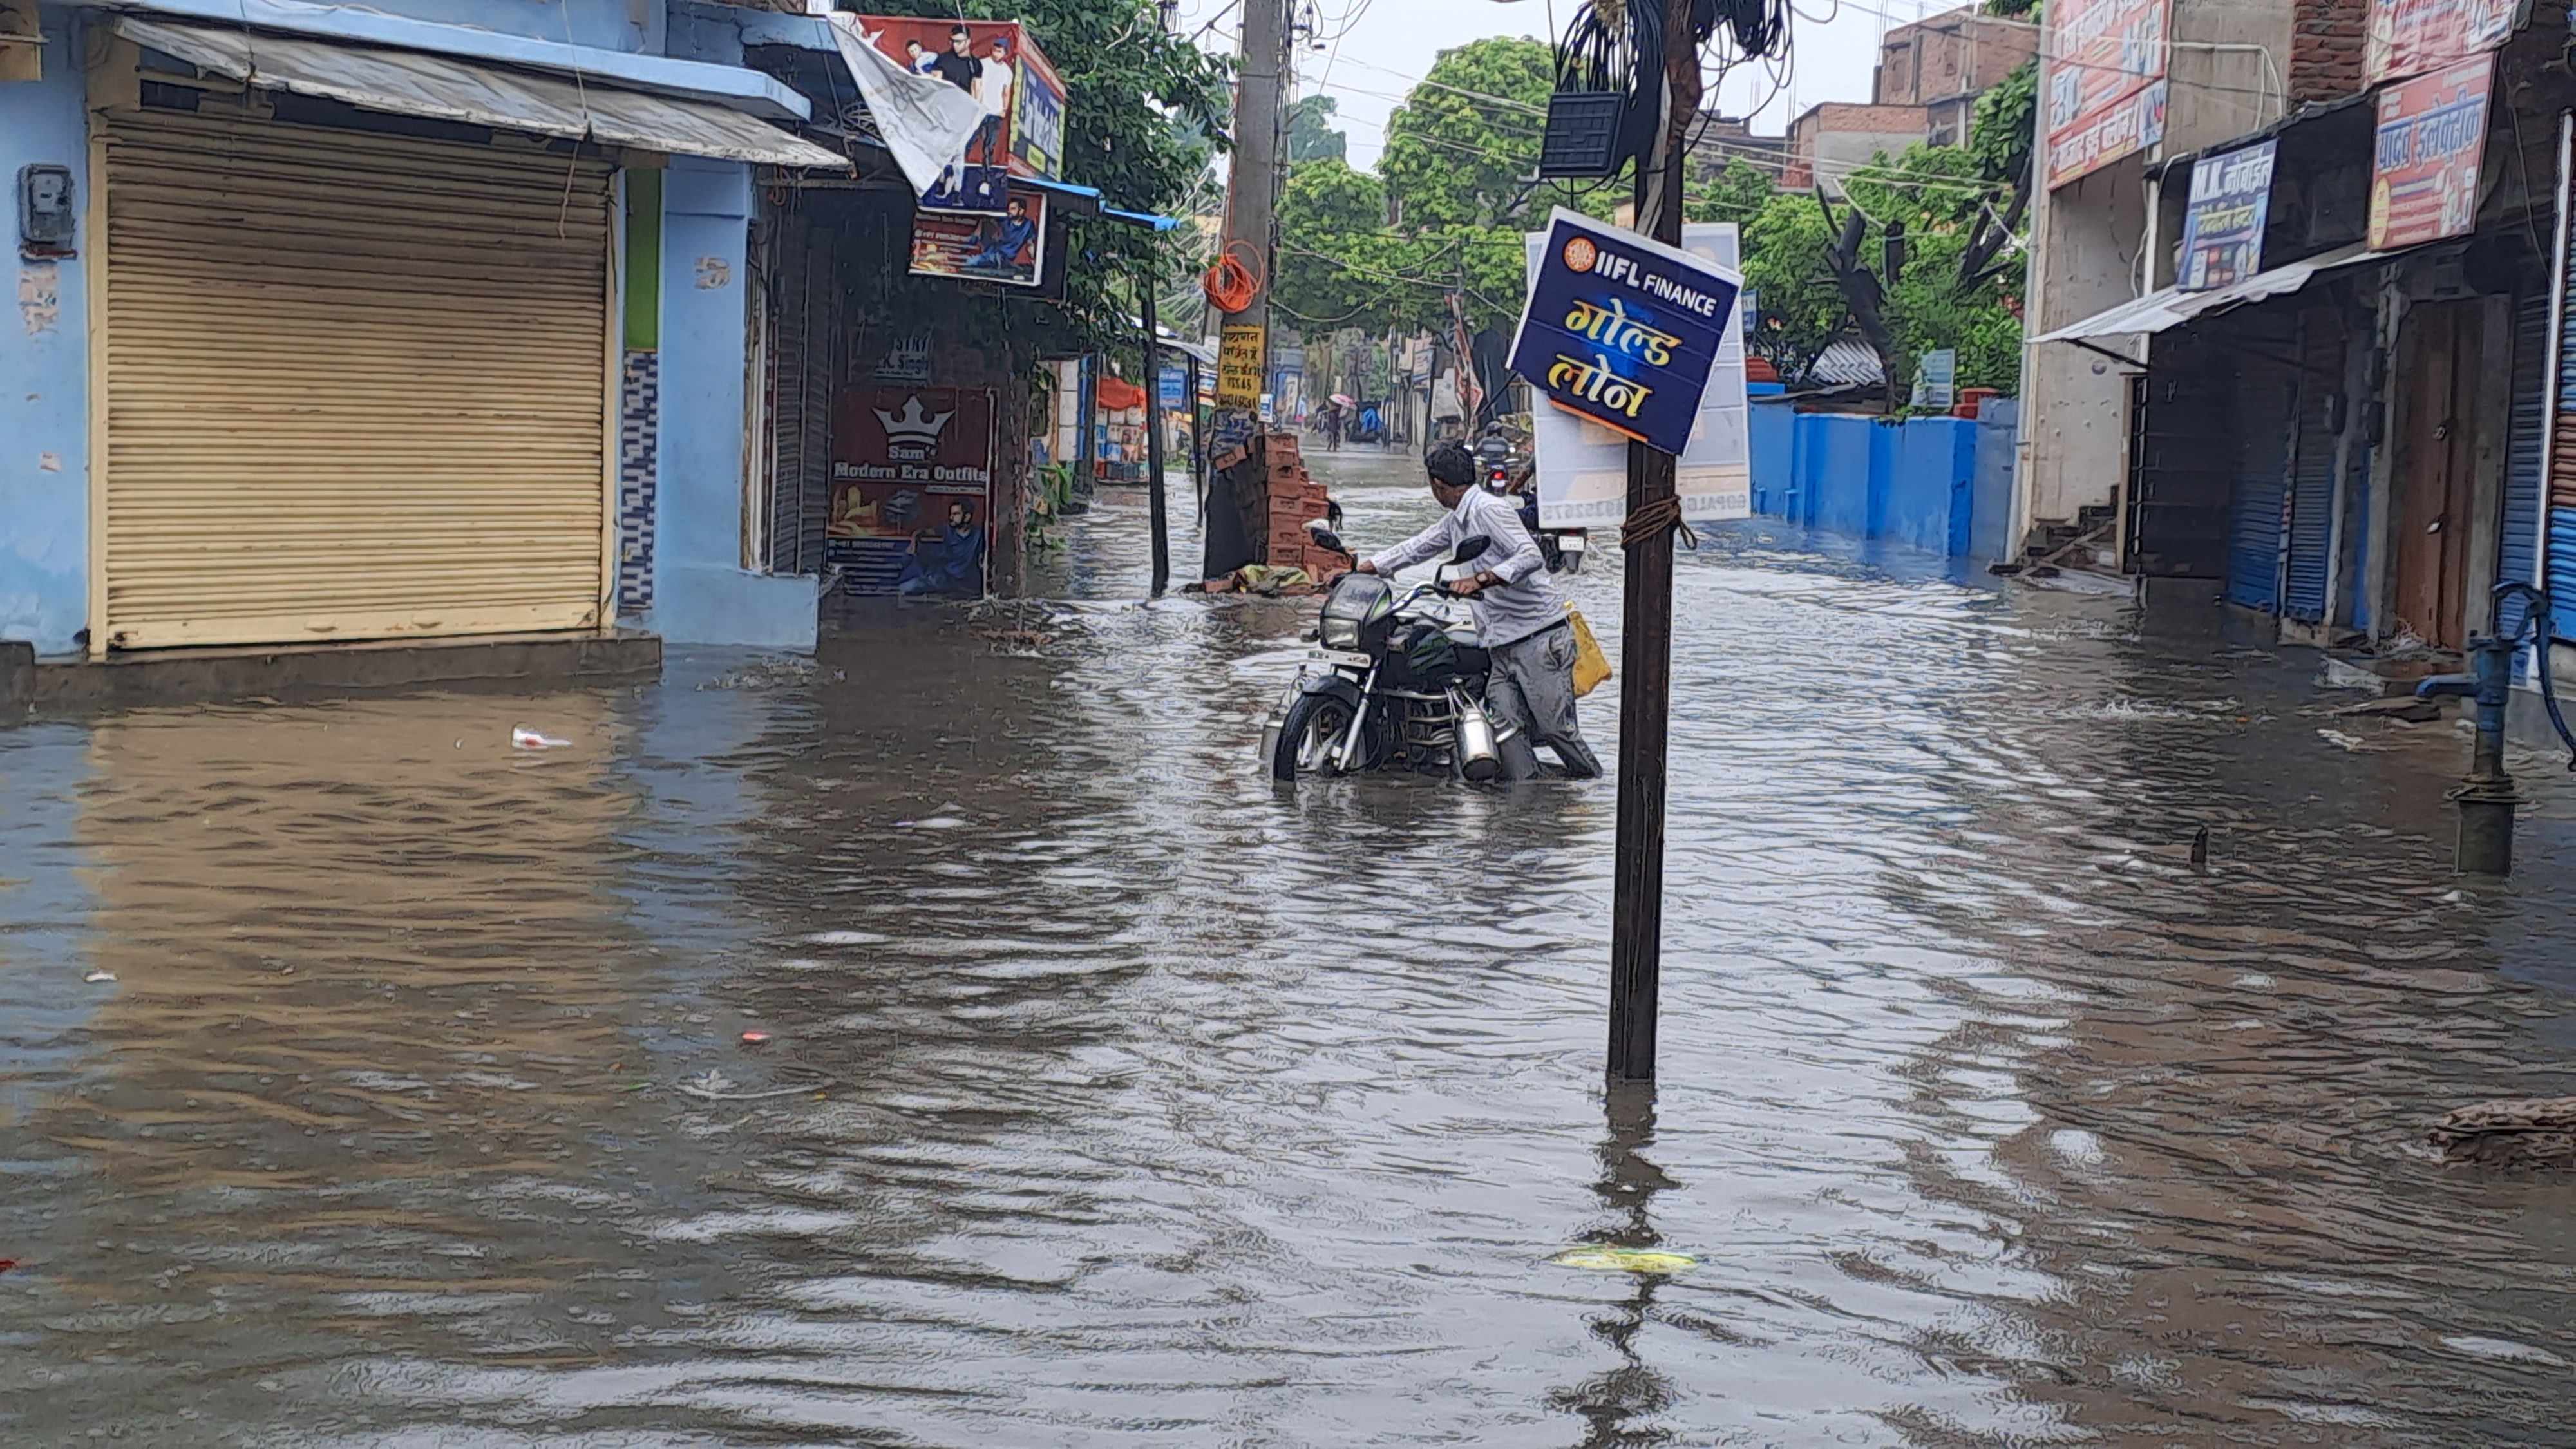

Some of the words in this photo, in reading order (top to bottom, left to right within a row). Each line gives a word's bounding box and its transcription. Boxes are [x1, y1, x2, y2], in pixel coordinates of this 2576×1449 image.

[1595, 251, 1640, 287] IIFL
[1643, 276, 1717, 317] FINANCE
[1565, 298, 1683, 366] गोल्ड
[1548, 354, 1653, 417] लोन
[833, 461, 896, 478] Modern
[901, 464, 929, 480] Era
[933, 466, 987, 482] Outfits
